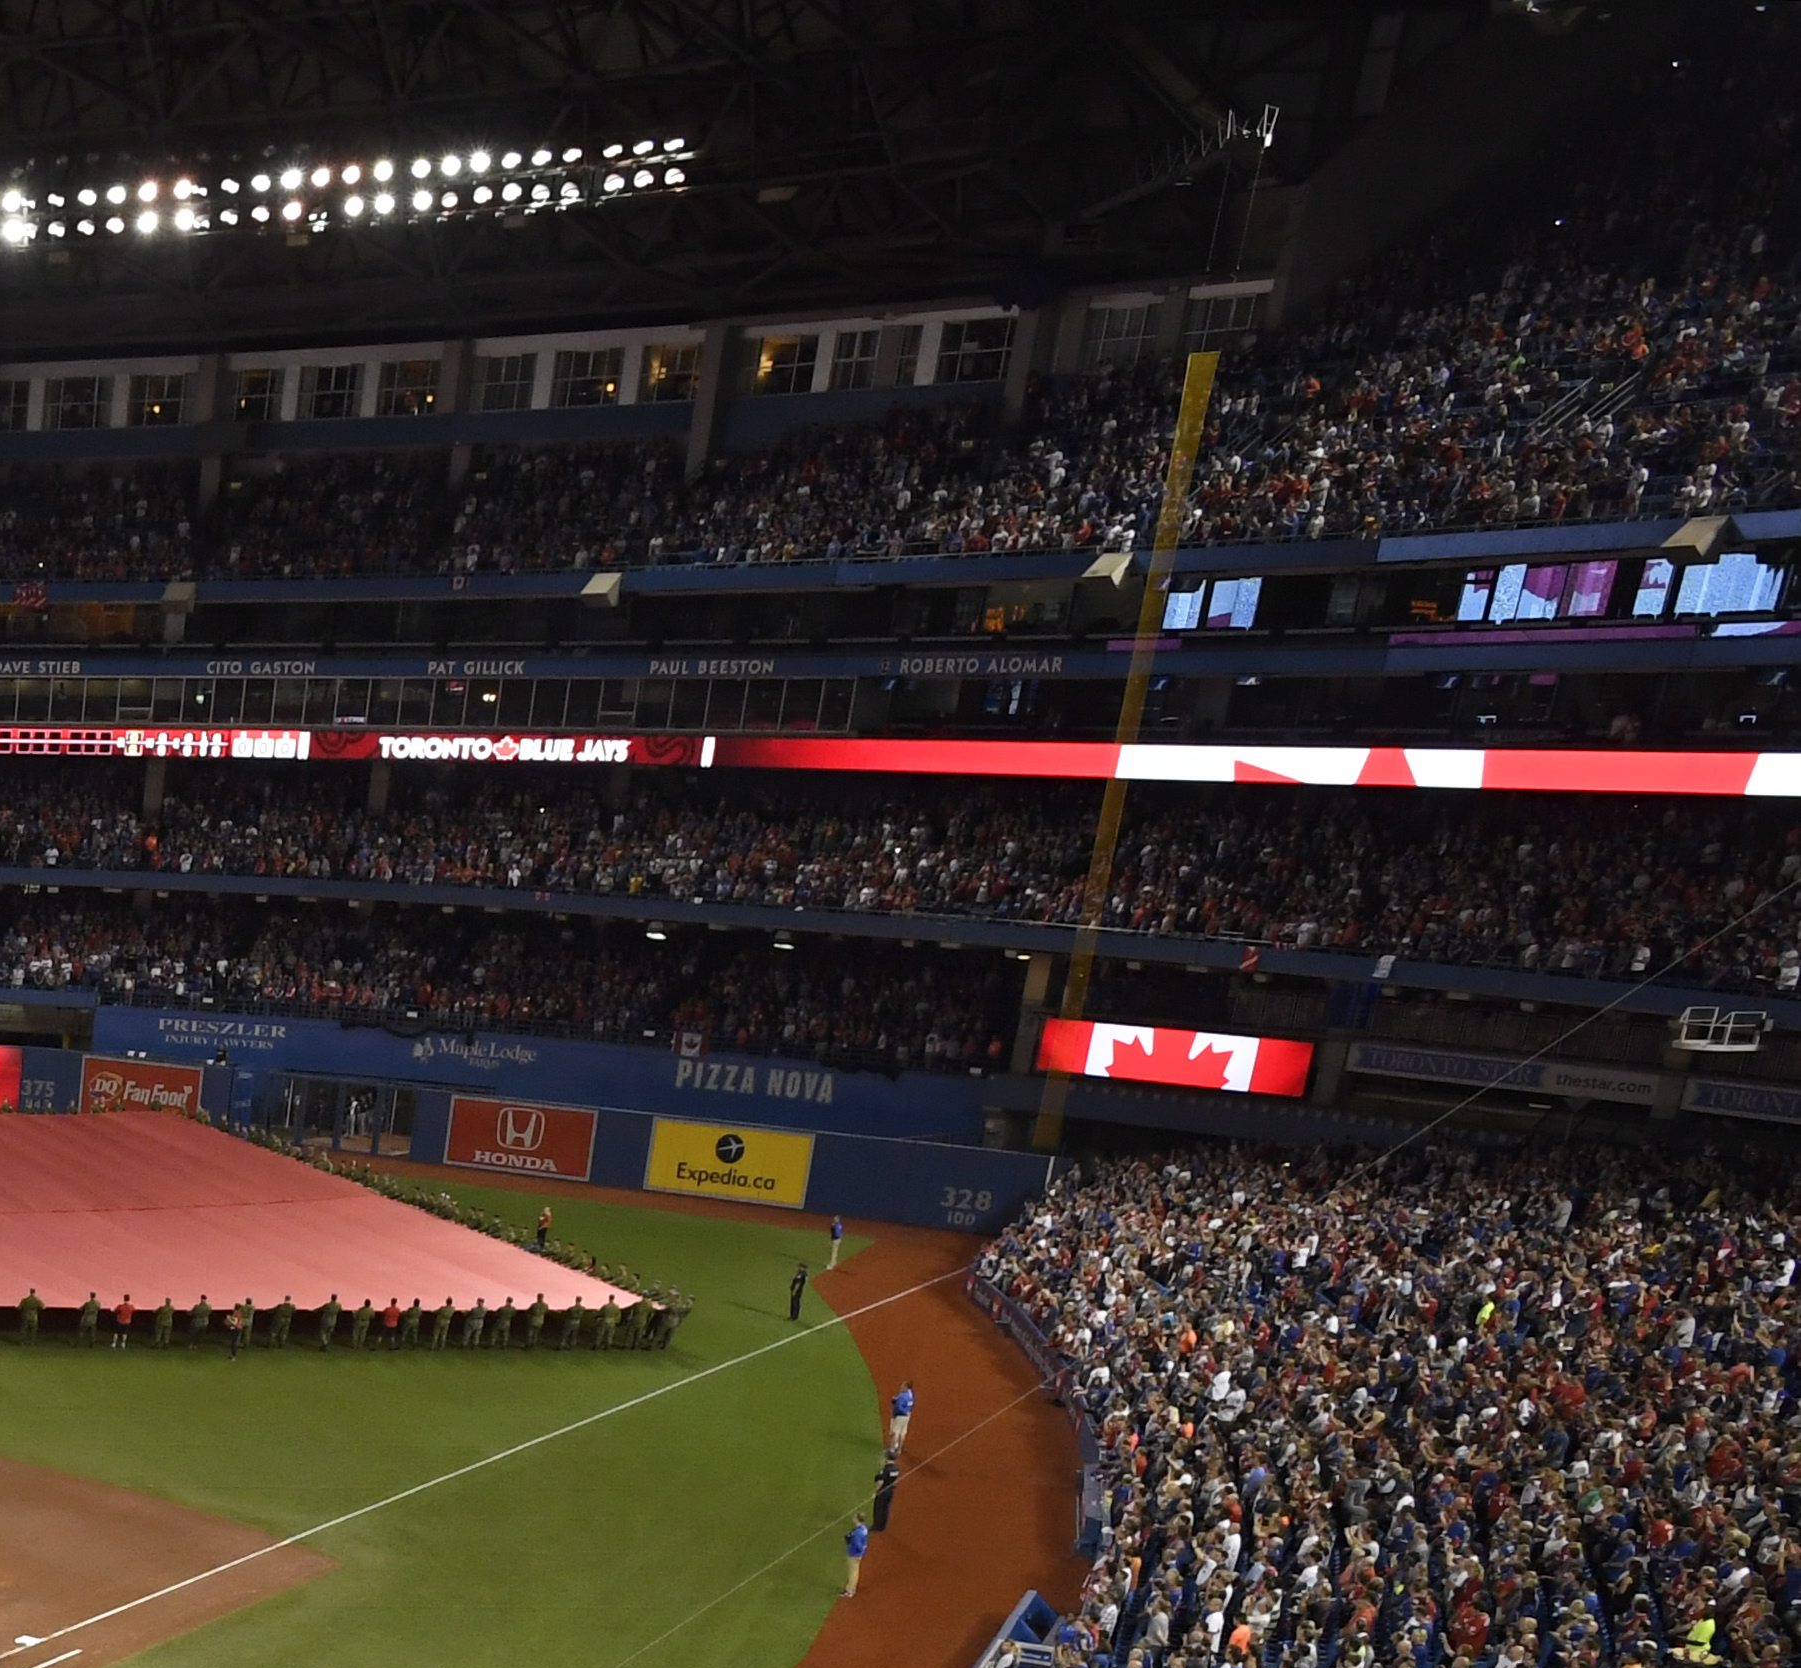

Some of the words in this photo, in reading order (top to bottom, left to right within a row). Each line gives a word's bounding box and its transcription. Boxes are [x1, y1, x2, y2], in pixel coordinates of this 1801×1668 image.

[38, 661, 81, 674] STIEB
[206, 661, 243, 674] CITO
[250, 661, 316, 675] GASTON
[428, 660, 456, 674] PAT
[464, 660, 525, 675] GILLICK
[650, 660, 689, 674] PAUL
[698, 660, 775, 675] BEESTON
[900, 658, 980, 674] ROBERTO
[987, 657, 1063, 674] ALOMAR
[379, 736, 493, 760] TORONTO
[518, 738, 576, 762] BLUE
[576, 739, 633, 763] JAYS
[158, 1018, 286, 1038] PRESZLER
[166, 1035, 208, 1046] INJURY
[213, 1036, 274, 1050] LAWYERS
[438, 1038, 487, 1060] Maple
[490, 1042, 537, 1065] Lodge
[21, 1079, 55, 1098] 375
[94, 1078, 118, 1095] DQ
[675, 1060, 755, 1094] PIZZA
[767, 1069, 833, 1105] NOVA
[1555, 1073, 1652, 1096] thestar.com
[472, 1150, 558, 1173] HONDA
[676, 1161, 776, 1191] Expedia.ca
[939, 1186, 993, 1212] 328
[947, 1212, 976, 1226] 100
